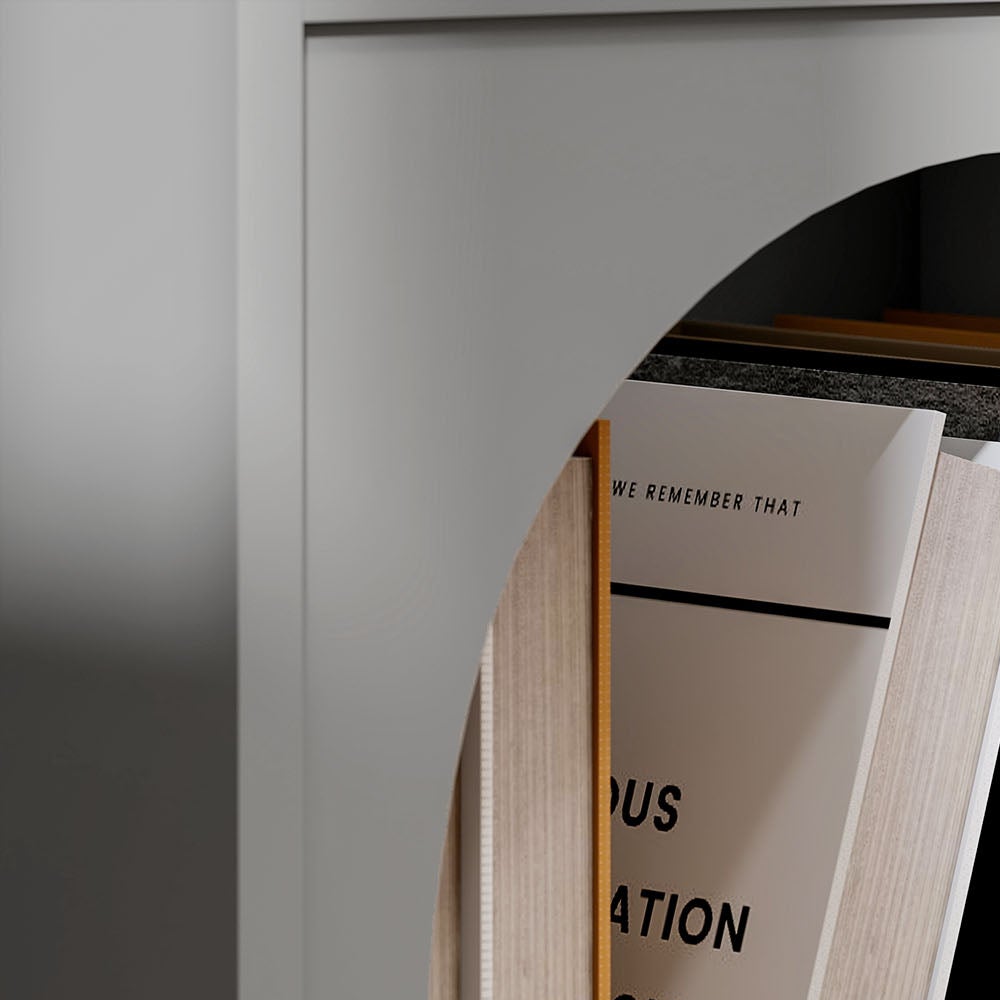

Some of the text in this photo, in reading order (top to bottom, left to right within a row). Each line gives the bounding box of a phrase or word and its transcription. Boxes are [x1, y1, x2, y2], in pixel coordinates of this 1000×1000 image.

[612, 479, 802, 518] WE REMEMBER THAT
[610, 775, 682, 832] US
[610, 884, 751, 953] ATION
